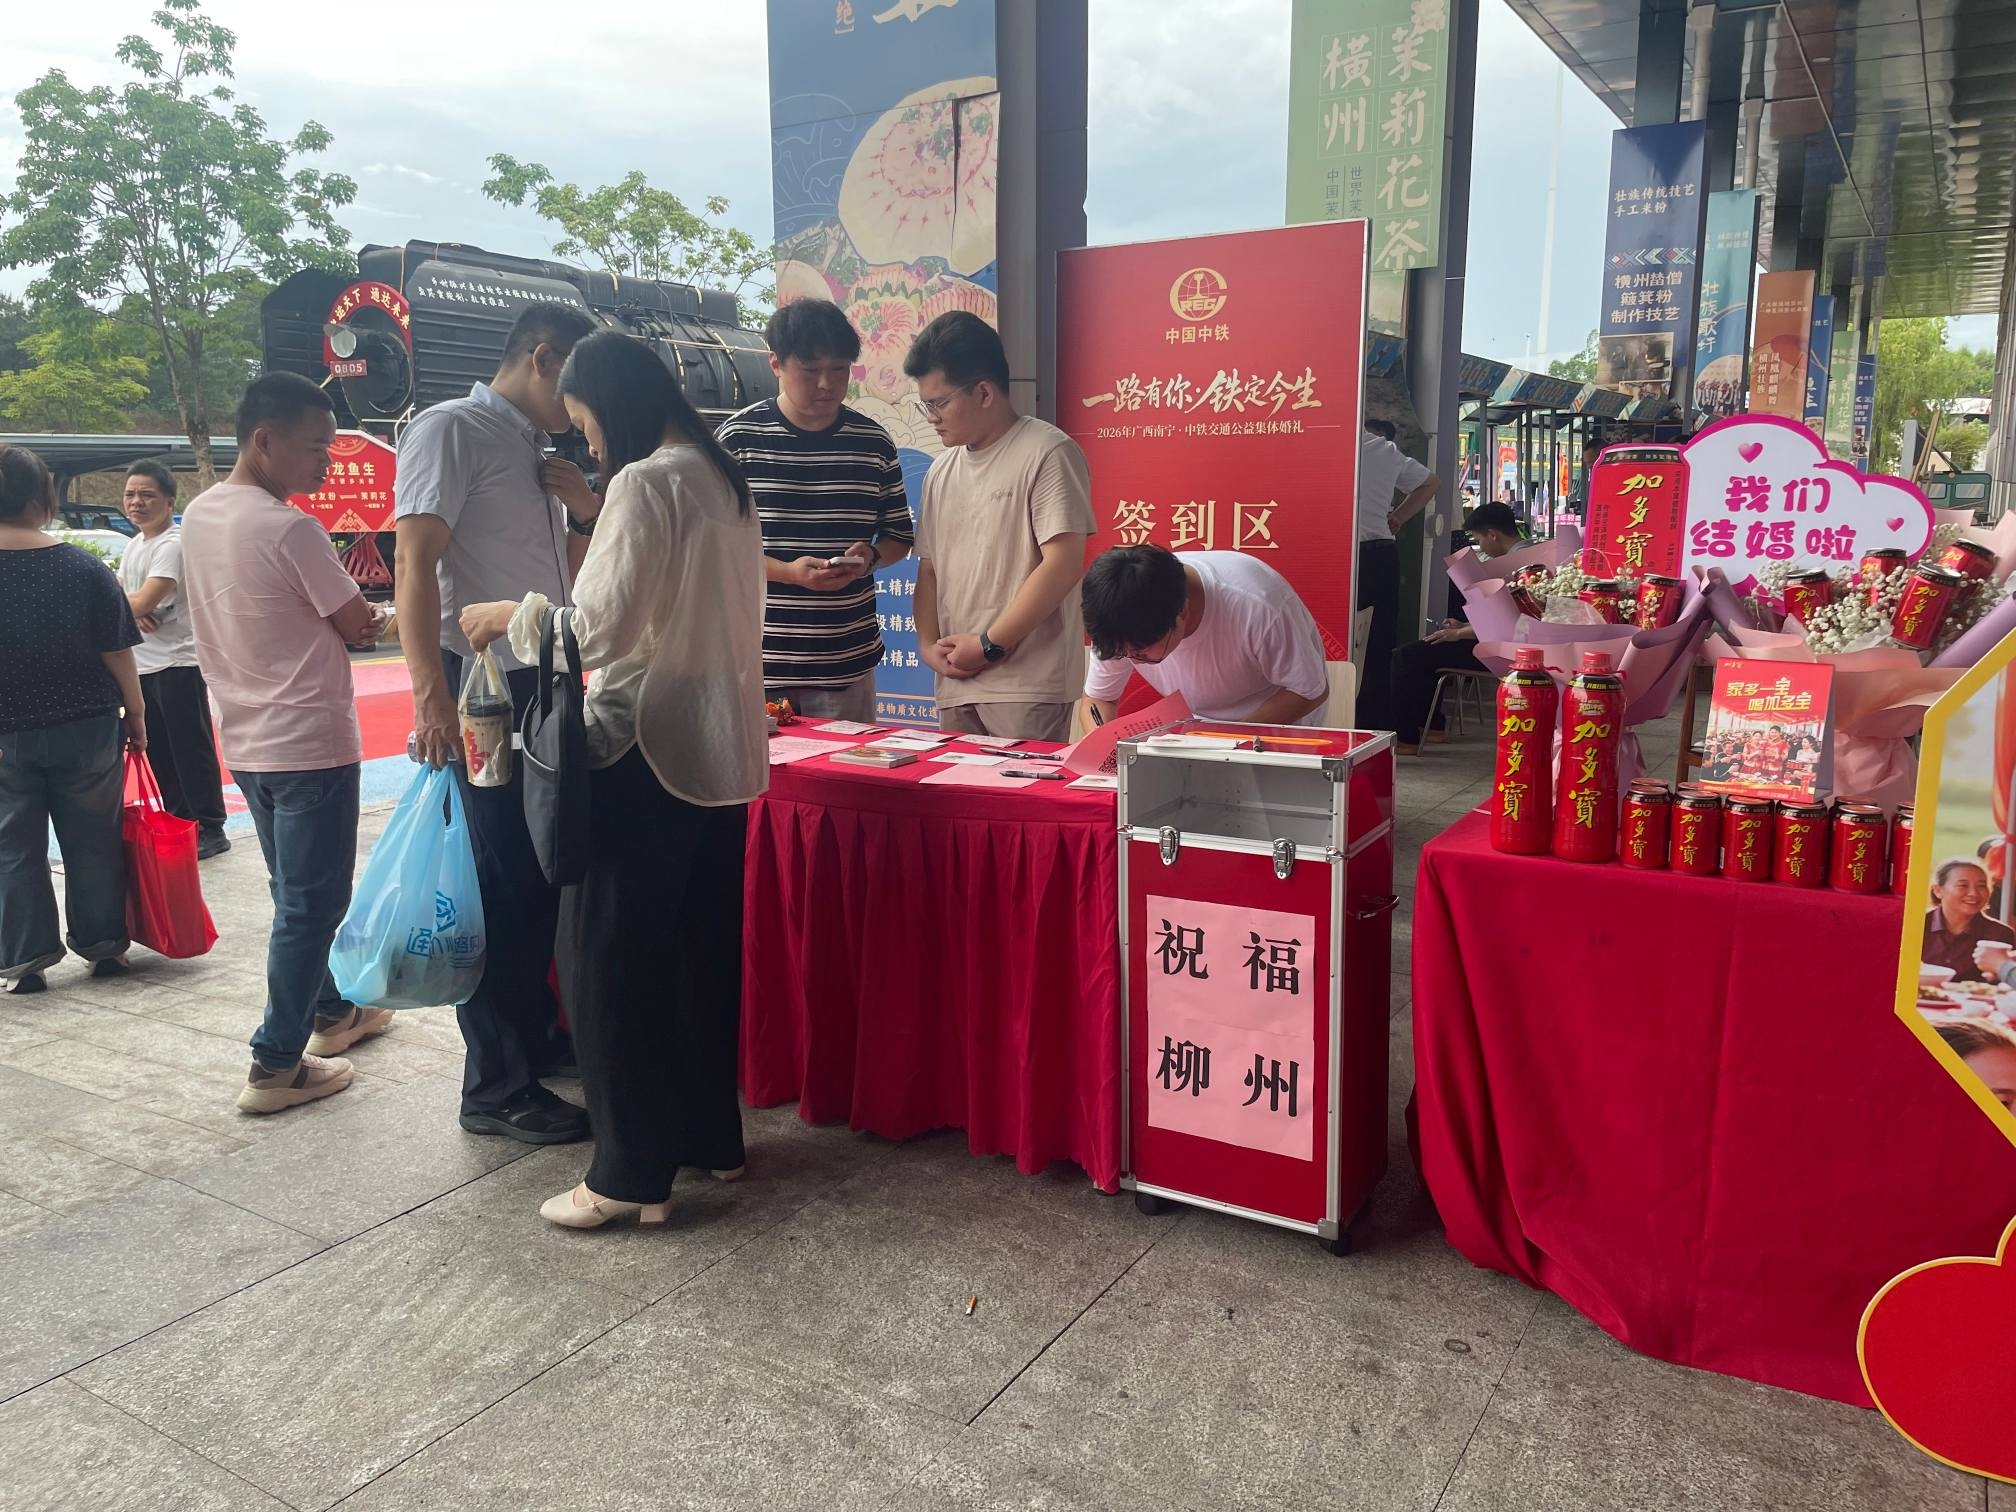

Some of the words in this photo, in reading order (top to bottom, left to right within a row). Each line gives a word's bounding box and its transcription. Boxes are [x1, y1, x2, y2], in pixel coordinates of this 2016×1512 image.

[1322, 34, 1373, 152] 横州
[1374, 26, 1432, 275] 茉莉花茶
[1325, 168, 1339, 219] 中国茉
[1350, 166, 1363, 218] 世界茉
[1614, 183, 1696, 202] 壮族传统技艺
[1614, 201, 1667, 218] 手工米粉
[1611, 306, 1681, 324] 制作技艺
[1620, 289, 1673, 306] 簸箕粉
[1165, 324, 1230, 344] 中国中铁
[326, 462, 375, 476] 龙鱼生
[1725, 475, 1831, 513] 我们
[1112, 499, 1280, 551] 签到区
[1690, 518, 1857, 561] 结婚啦
[1726, 676, 1791, 697] 家多一宝
[1748, 691, 1812, 712] 喝加多宝
[1153, 918, 1302, 995] 祝福
[1155, 1035, 1300, 1118] 柳州
